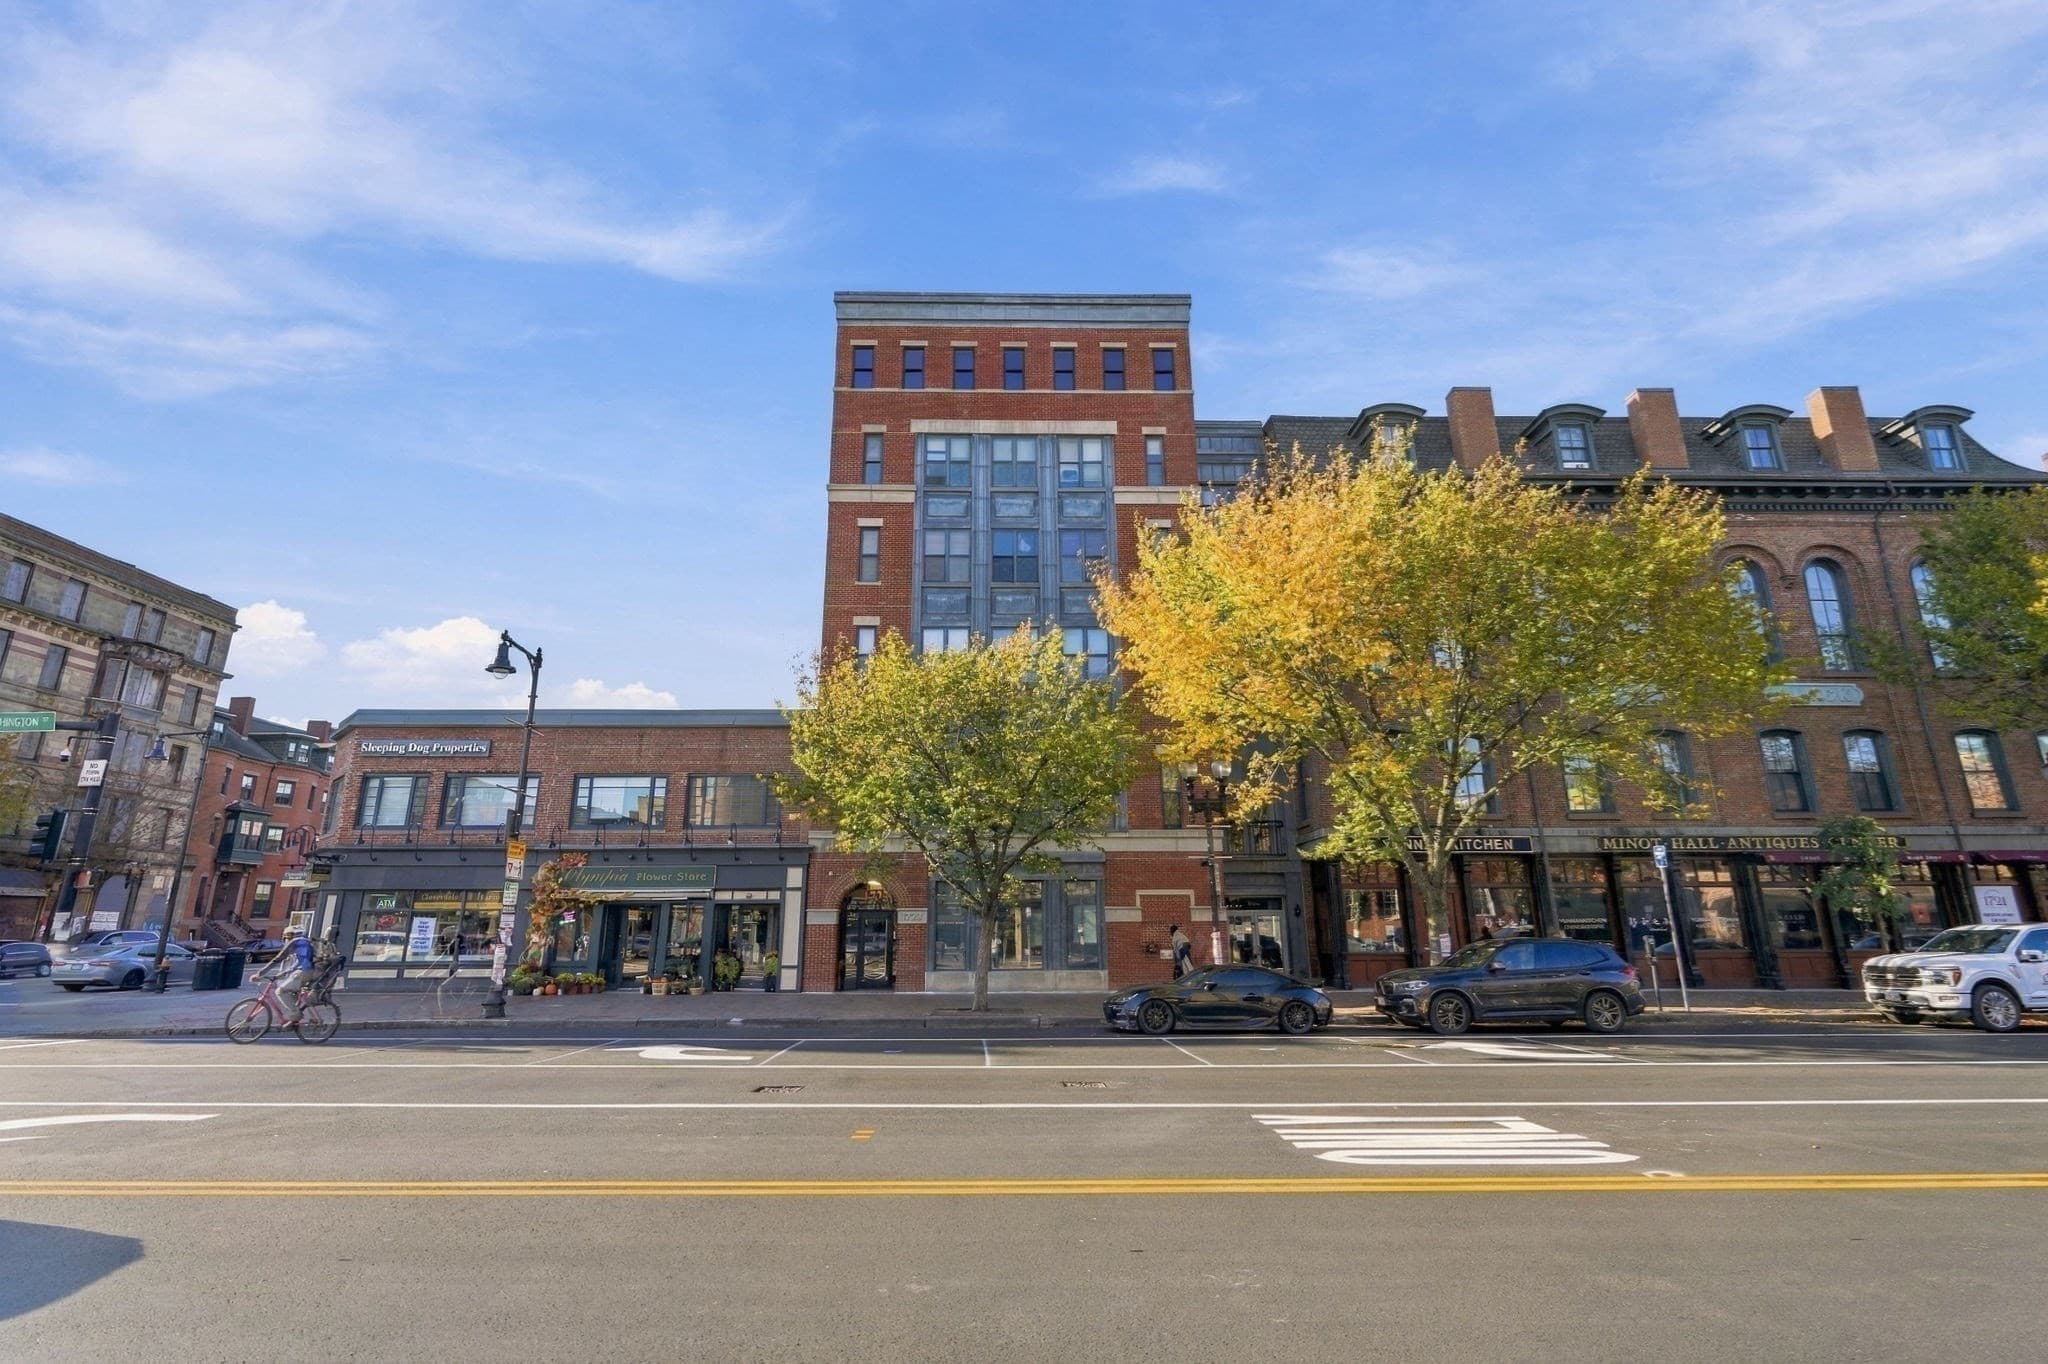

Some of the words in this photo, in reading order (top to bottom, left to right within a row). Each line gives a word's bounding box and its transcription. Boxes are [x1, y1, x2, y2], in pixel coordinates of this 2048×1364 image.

[360, 742, 405, 754] Sleeping
[408, 742, 430, 754] Dog
[432, 742, 487, 754] Properties
[1603, 837, 1662, 849] MINOT
[1671, 837, 1718, 849] HALL
[1727, 837, 1820, 849] ANTIQUES
[636, 872, 673, 881] Flower
[677, 872, 707, 881] Store
[377, 900, 396, 909] ATM
[1251, 1114, 1641, 1165] ONLY
